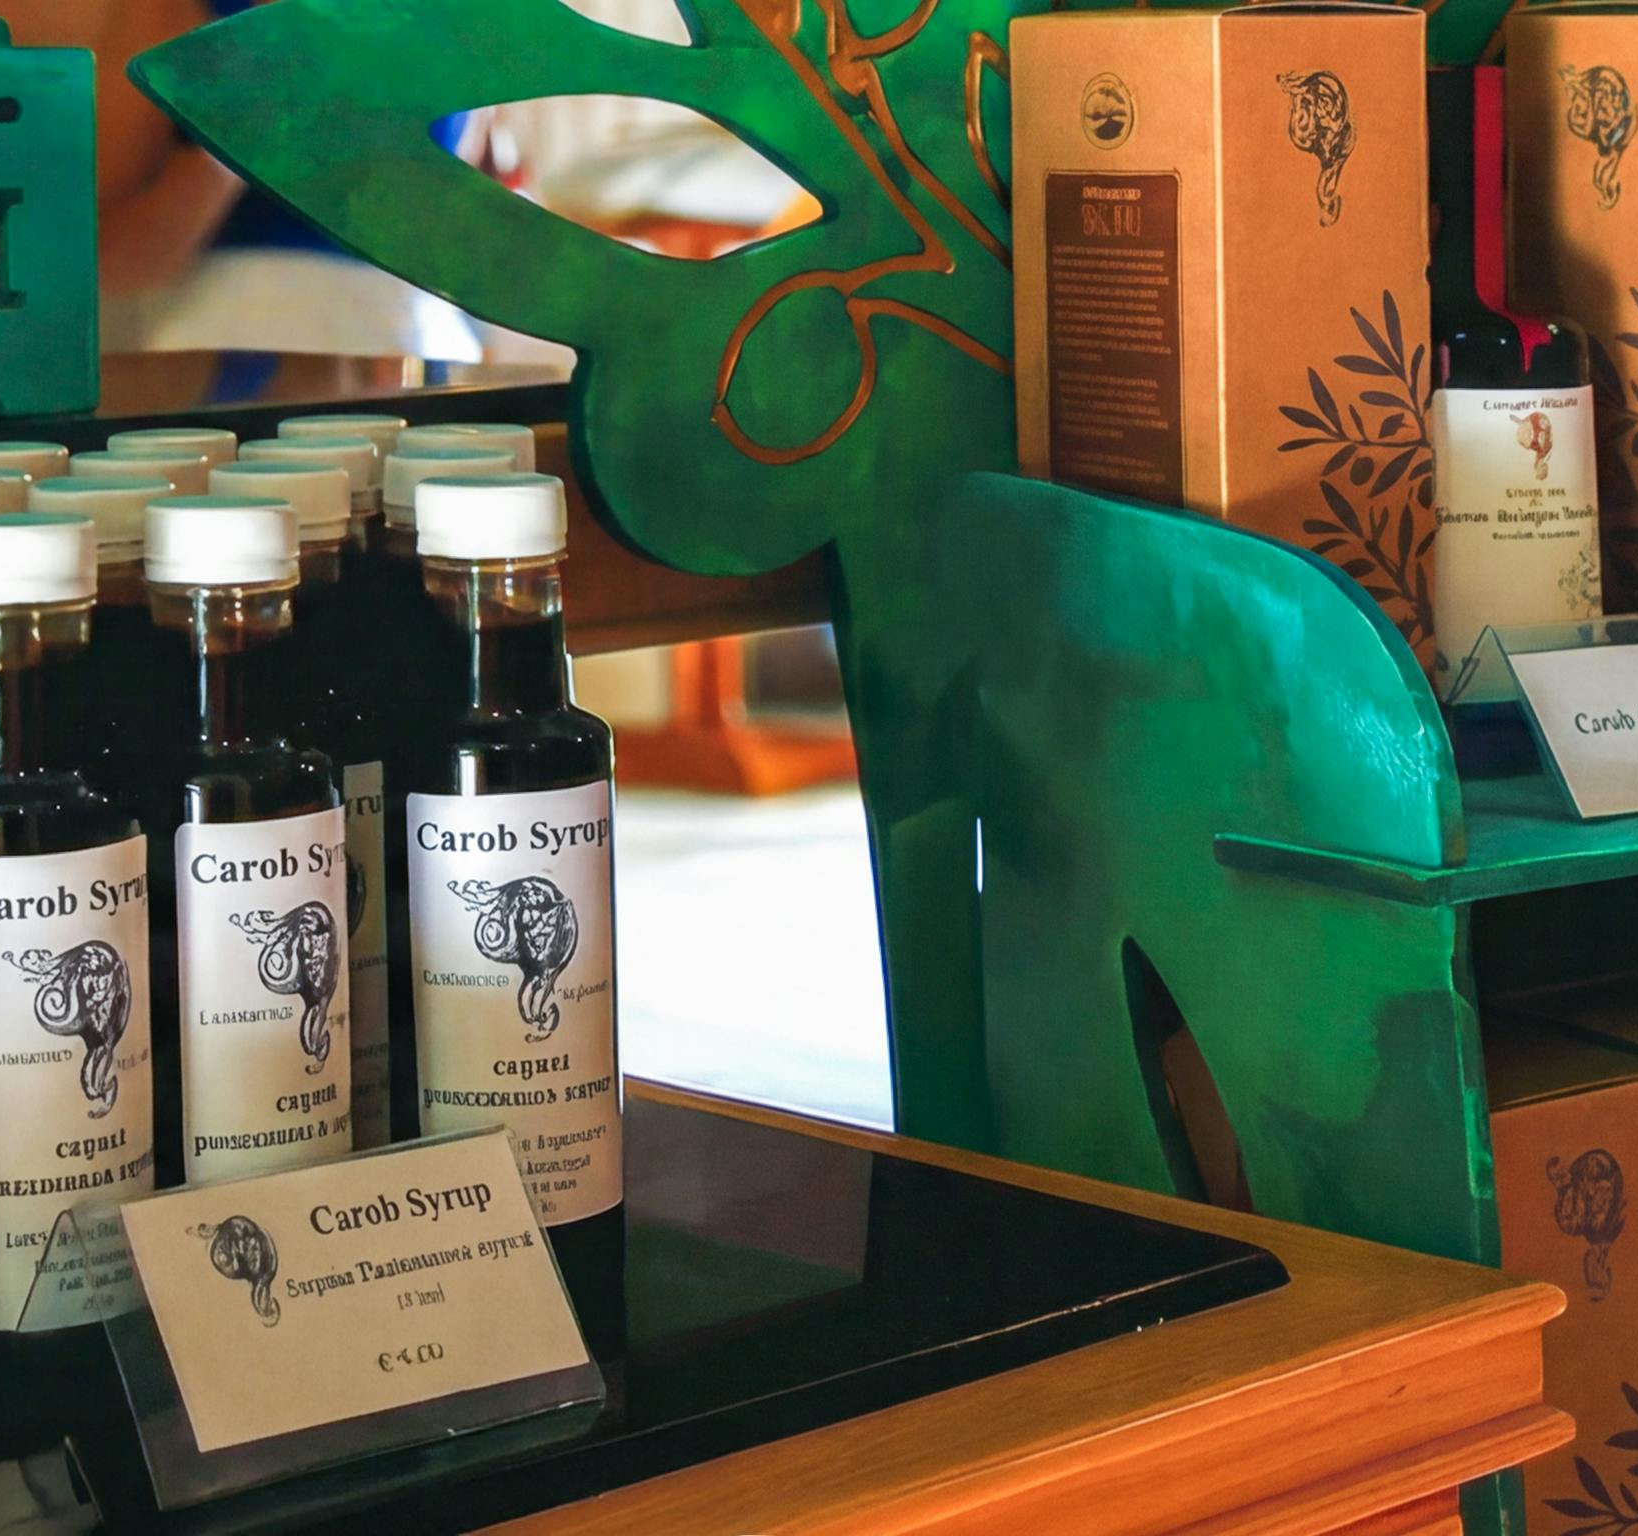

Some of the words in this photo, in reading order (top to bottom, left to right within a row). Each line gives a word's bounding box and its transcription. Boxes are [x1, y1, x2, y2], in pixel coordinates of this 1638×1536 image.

[417, 821, 518, 853] Carob
[190, 842, 299, 885] Carob
[309, 1194, 401, 1236] Carob
[405, 1181, 492, 1223] Syrup
